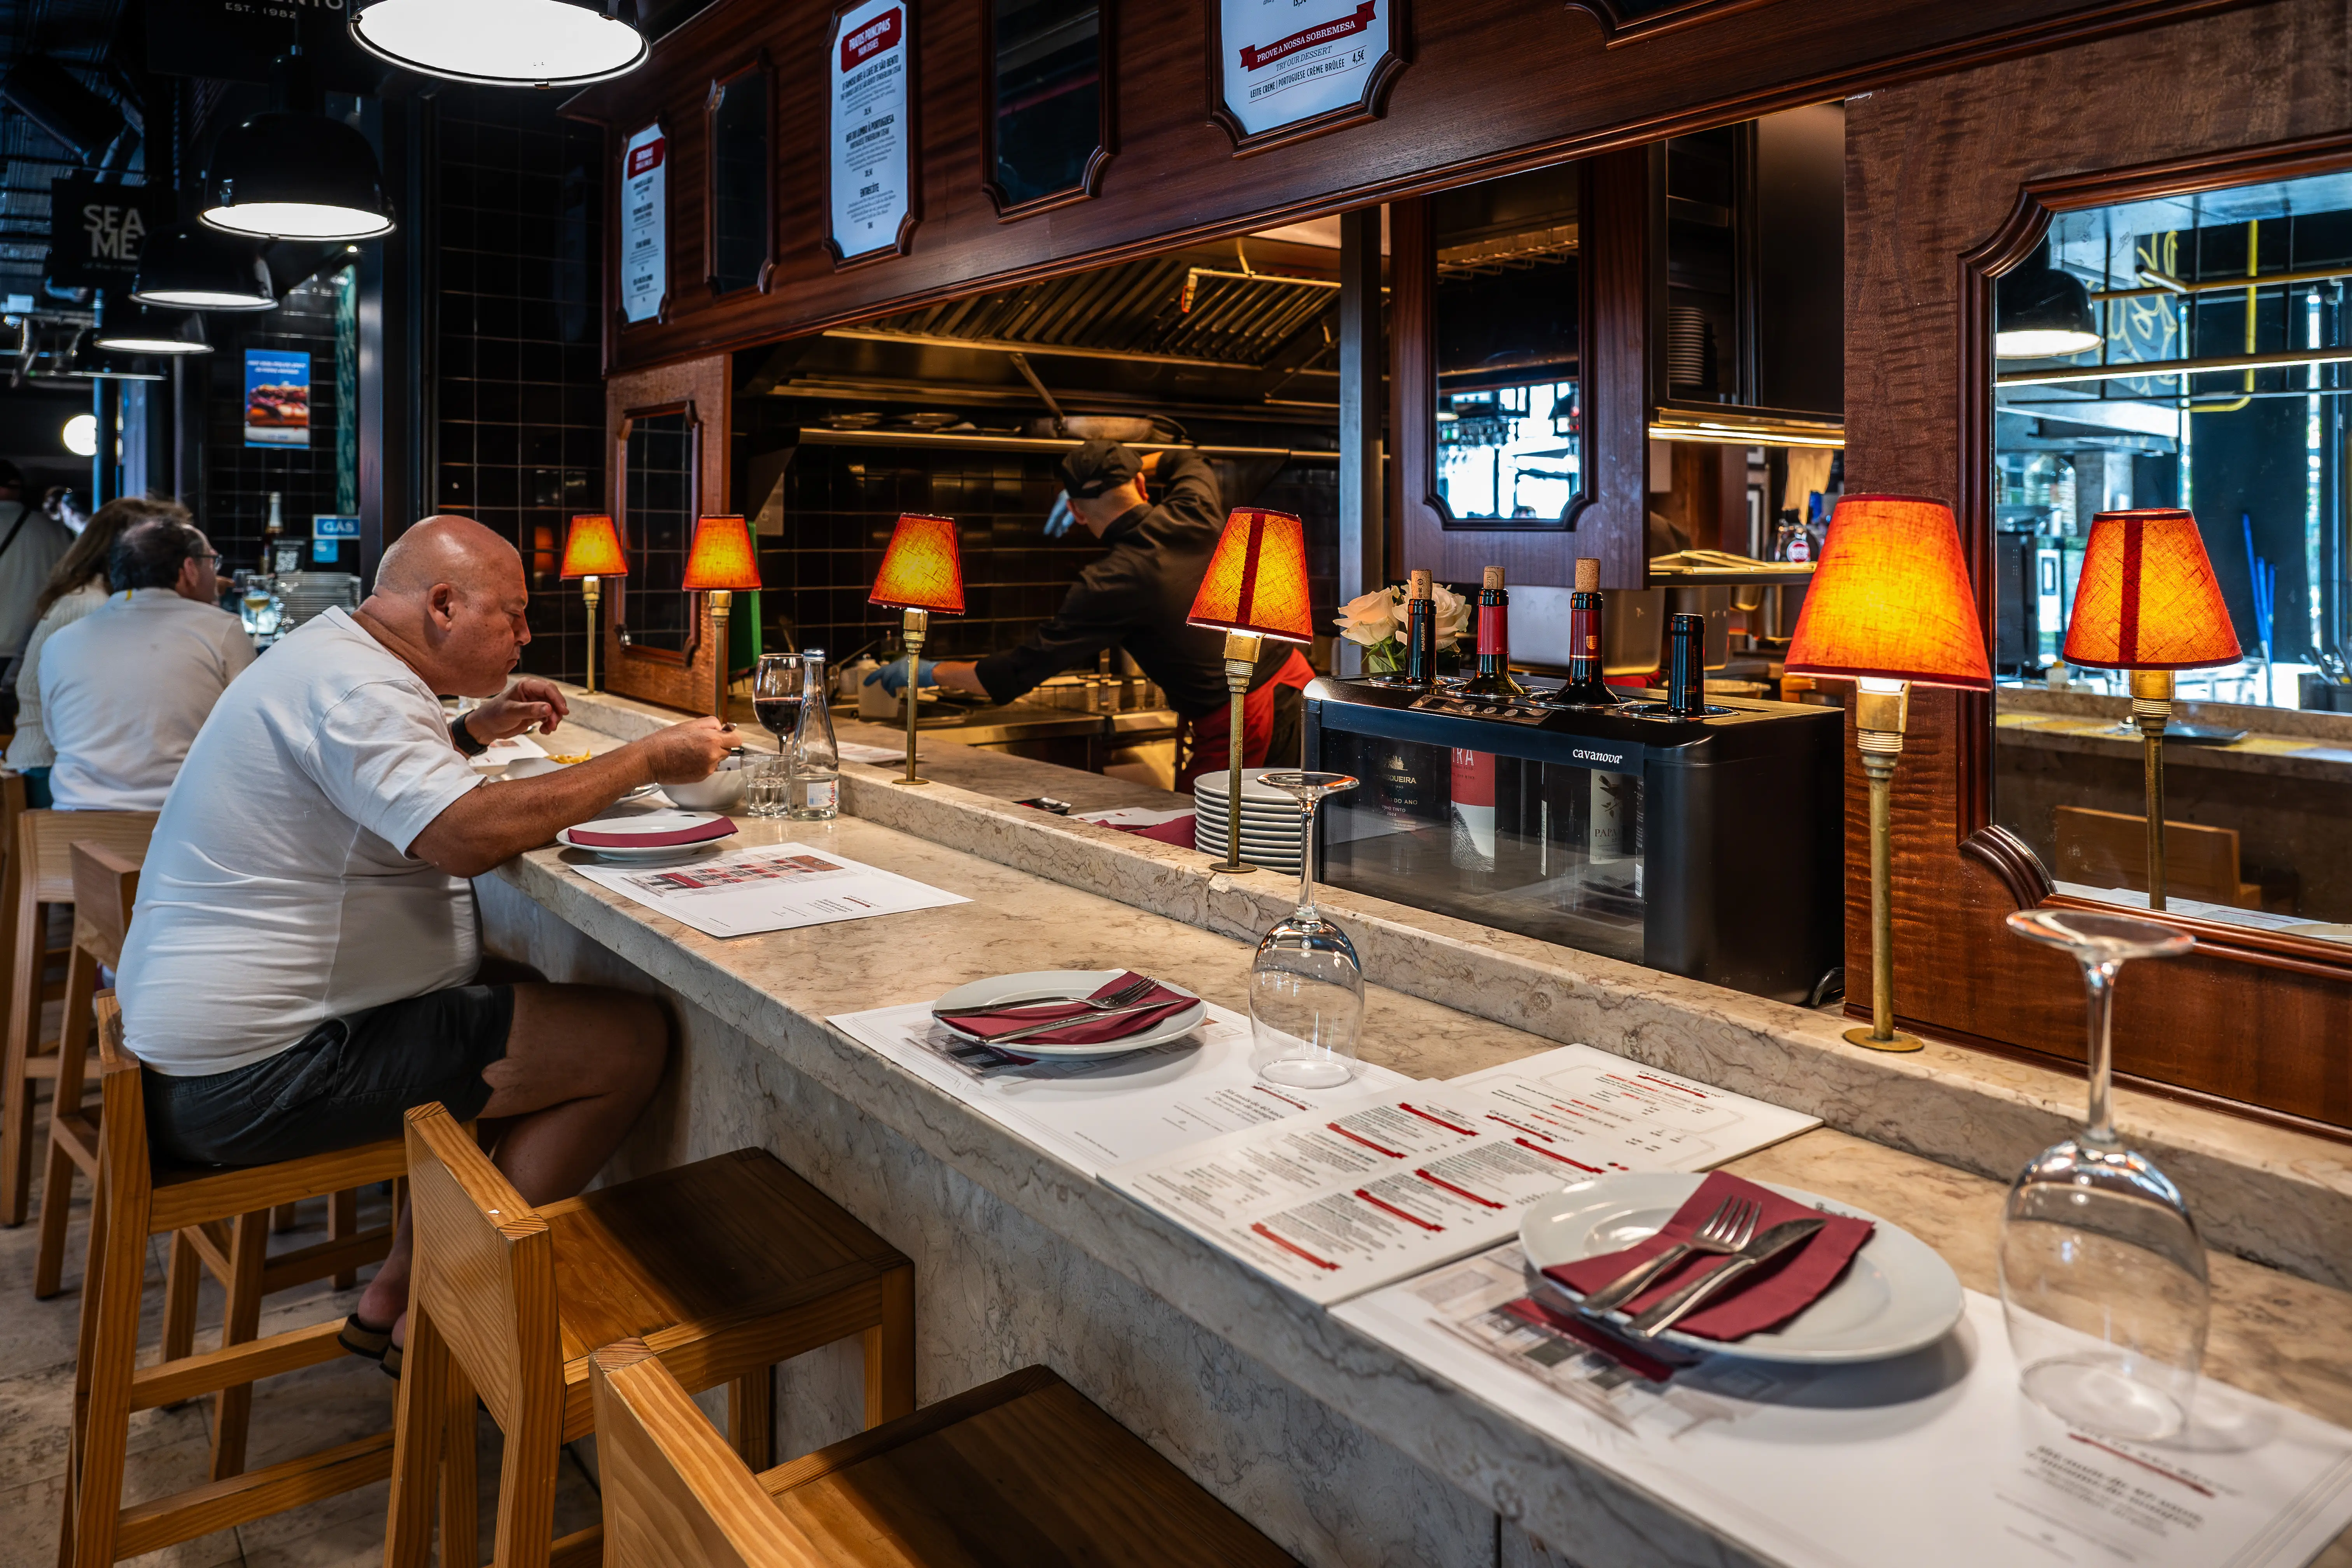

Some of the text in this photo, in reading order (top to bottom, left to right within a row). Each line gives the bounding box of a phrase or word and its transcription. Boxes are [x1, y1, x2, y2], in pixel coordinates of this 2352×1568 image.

[226, 2, 255, 13] EST.
[864, 18, 891, 41] PRINCIPAIS
[1257, 48, 1278, 63] PROVE
[1283, 37, 1305, 51] NOSSA
[1306, 21, 1355, 43] SOBREMESA
[1251, 49, 1364, 98] LEITE CREME PORTUGUESE CRÈME BRÛLÉE 4,5€
[1276, 46, 1332, 71] TRY OUR DESSERT
[82, 203, 146, 236] SEA
[91, 231, 139, 261] ME
